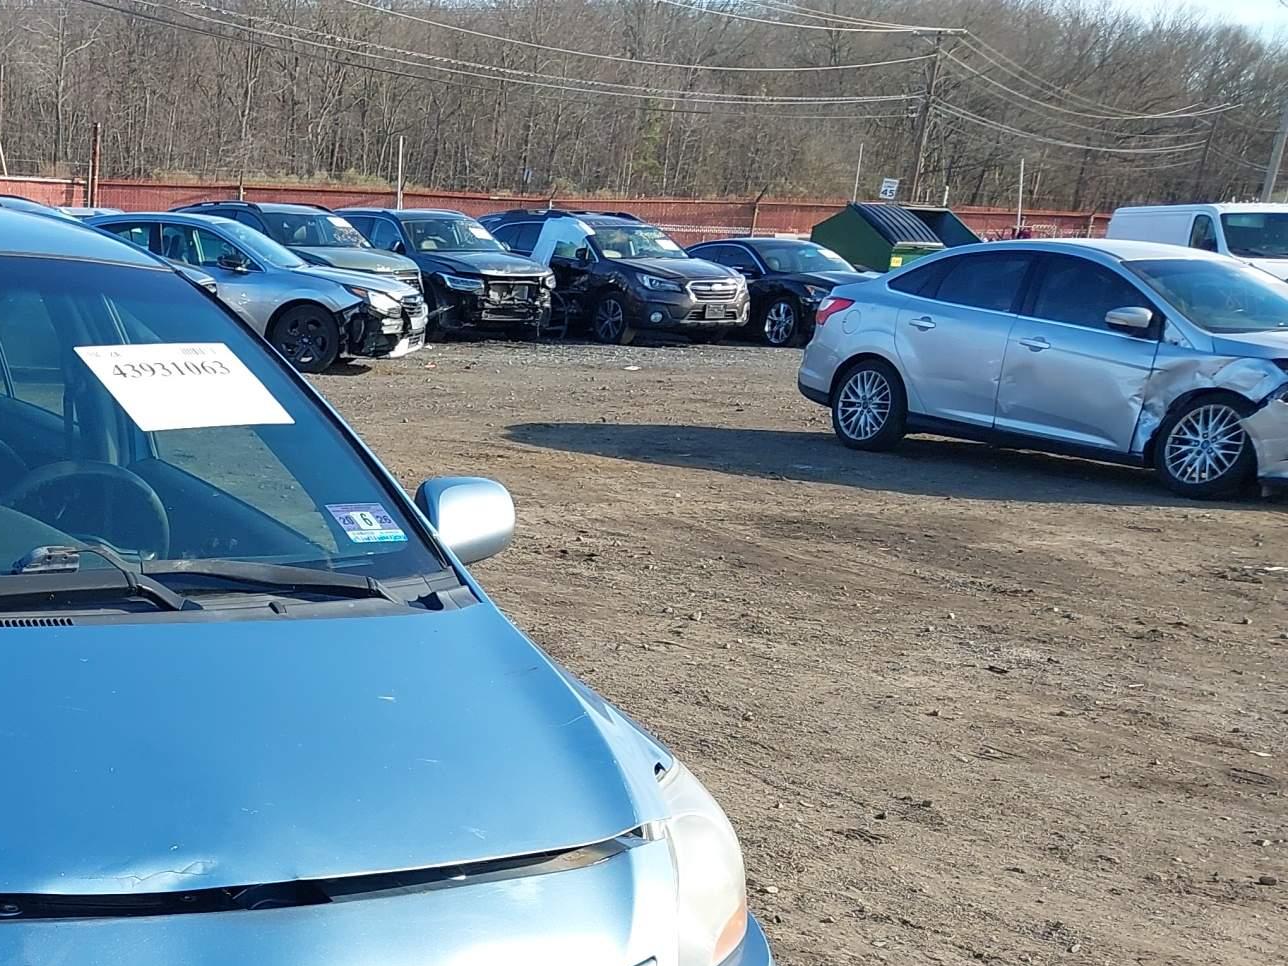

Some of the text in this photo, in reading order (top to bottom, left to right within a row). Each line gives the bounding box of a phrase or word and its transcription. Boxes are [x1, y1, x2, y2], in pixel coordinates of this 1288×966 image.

[881, 188, 895, 197] 45
[113, 361, 231, 378] 43931063
[339, 515, 355, 525] 20
[360, 513, 373, 526] 6
